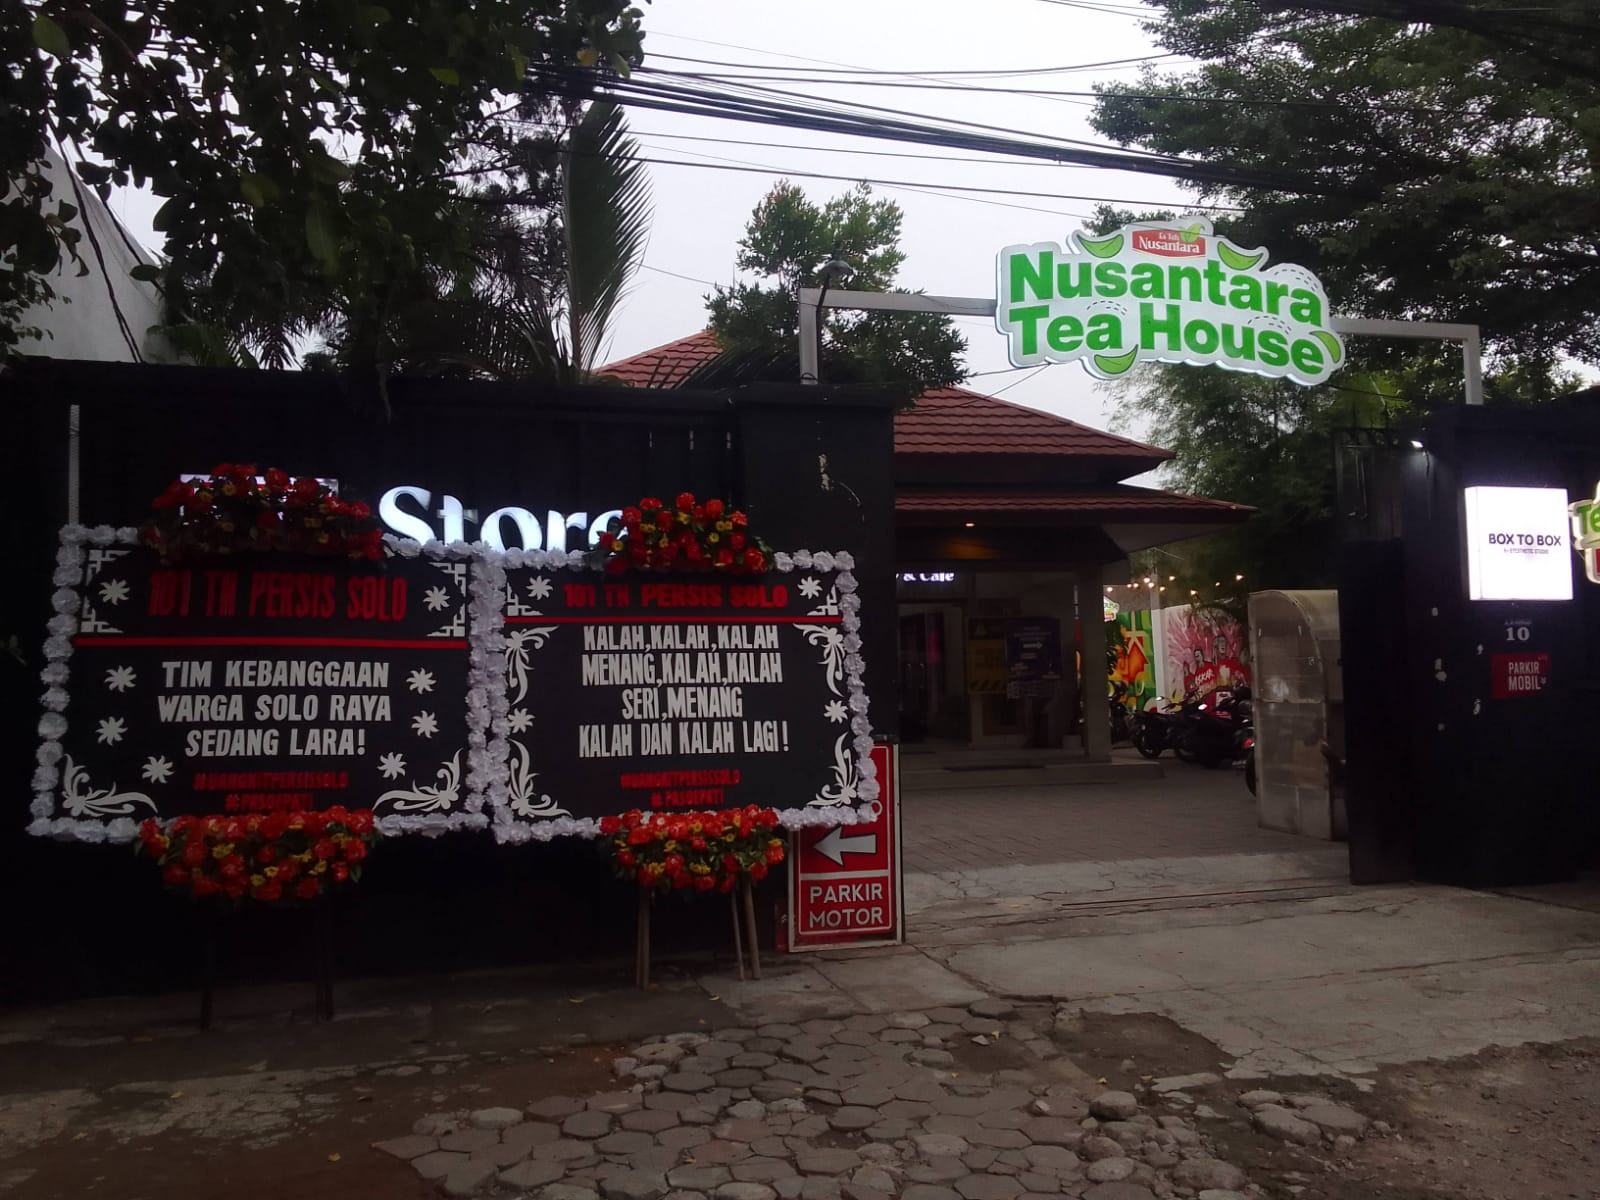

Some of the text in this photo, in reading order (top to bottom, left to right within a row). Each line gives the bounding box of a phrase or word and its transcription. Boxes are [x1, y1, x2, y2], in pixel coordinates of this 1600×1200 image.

[1139, 236, 1200, 253] Nusantara
[1009, 251, 1321, 327] Nusantara
[1009, 303, 1325, 375] Tea House
[1488, 533, 1562, 547] BOX TO BOX
[148, 570, 192, 617] 101
[249, 571, 336, 620] PERSIS
[346, 574, 408, 622] SOLO
[563, 583, 596, 609] 101
[641, 583, 723, 609] PERSIS
[729, 583, 789, 609] SOLO
[1506, 626, 1531, 641] 10
[162, 660, 390, 688] TIM KEBANGGAAN
[1508, 661, 1541, 675] PARKIR
[1508, 675, 1542, 691] MOBIL
[158, 694, 392, 723] WARGA SOLO RAYA
[185, 728, 366, 757] SEDANG LARA!
[578, 720, 790, 758] KALAH DAN KALAH LAGI!
[810, 882, 884, 904] PARKIR
[809, 906, 884, 929] MOTOR
